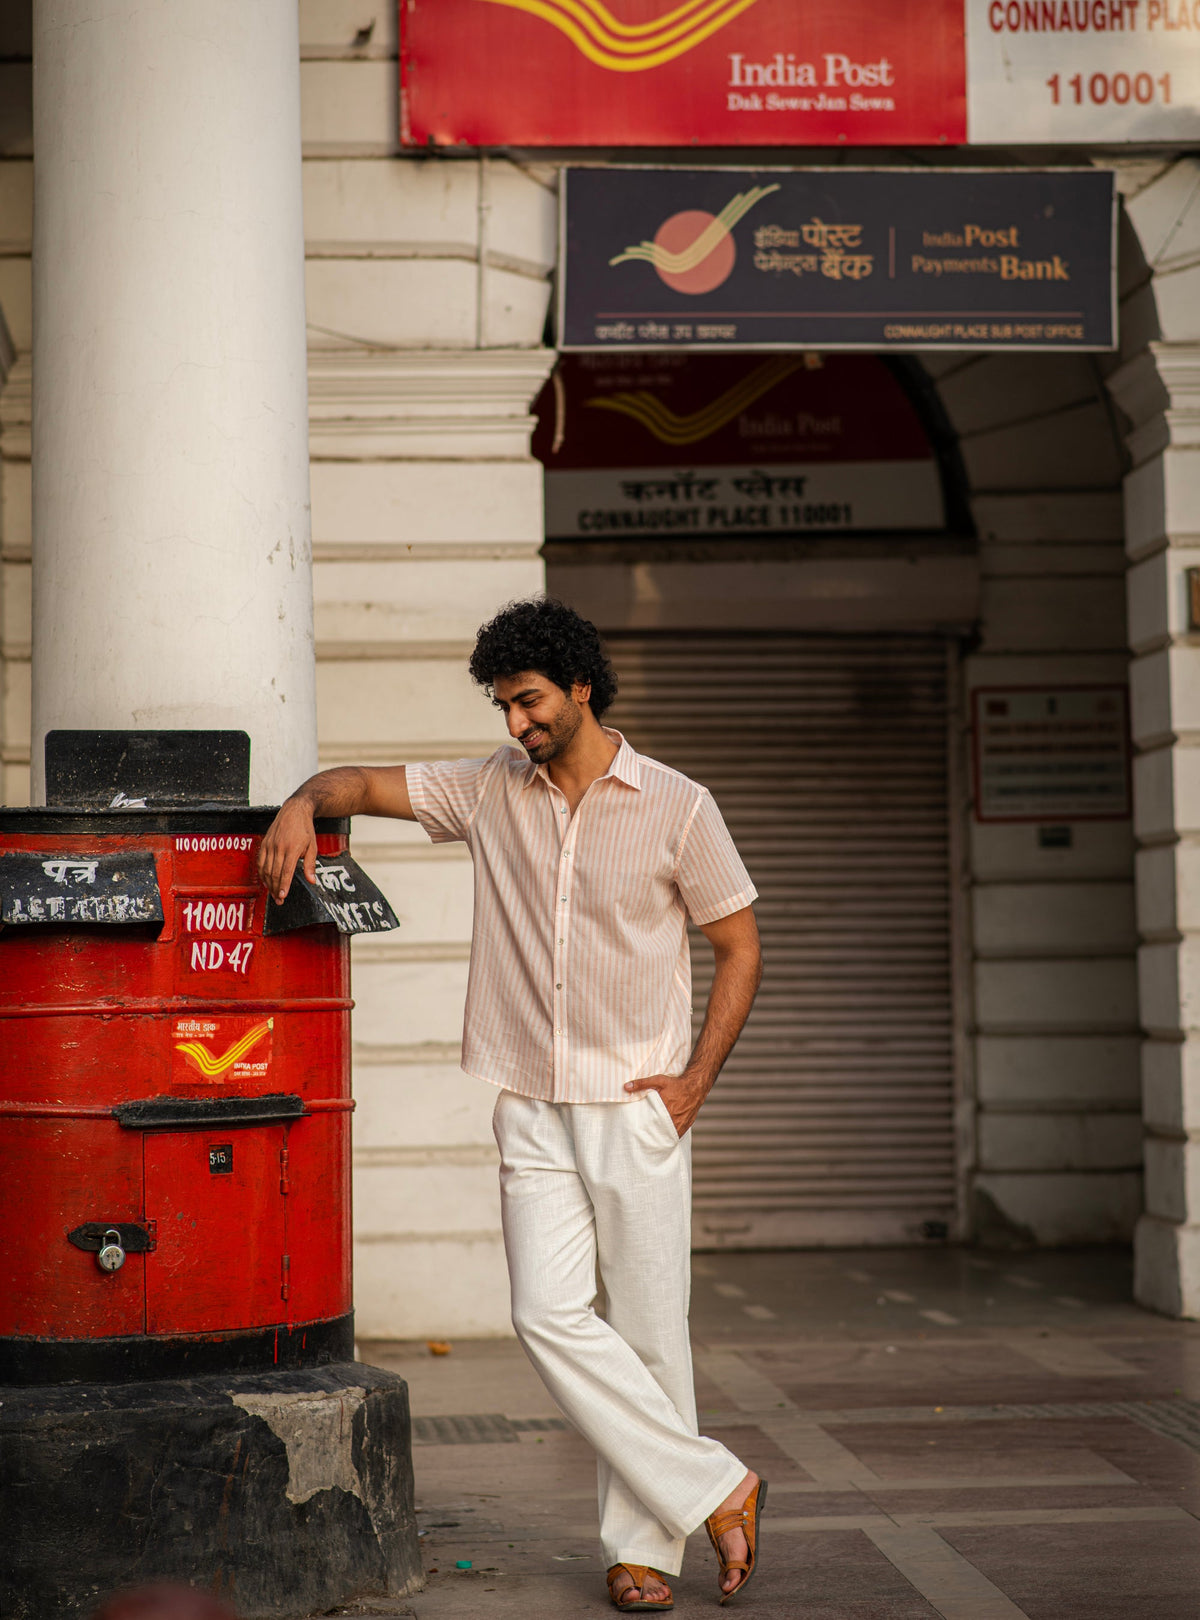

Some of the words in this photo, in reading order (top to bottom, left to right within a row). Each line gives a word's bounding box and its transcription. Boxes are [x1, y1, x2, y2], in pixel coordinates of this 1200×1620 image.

[989, 0, 1137, 33] CONNAUGHT
[729, 53, 817, 87] India
[823, 53, 895, 87] Post
[728, 93, 763, 111] Dak
[849, 93, 895, 111] Sewa
[1046, 73, 1173, 104] 110001
[800, 216, 864, 248] पोस्ट
[922, 231, 963, 247] India
[964, 224, 1019, 248] Post
[819, 247, 874, 280] बैंक
[911, 255, 998, 277] Payments
[999, 255, 1069, 280] Bank
[578, 507, 701, 531] CONNAUGHT
[707, 505, 772, 528] PLACE
[175, 836, 253, 852] 110001000097
[182, 901, 245, 932] 110001
[251, 1062, 268, 1071] POST
